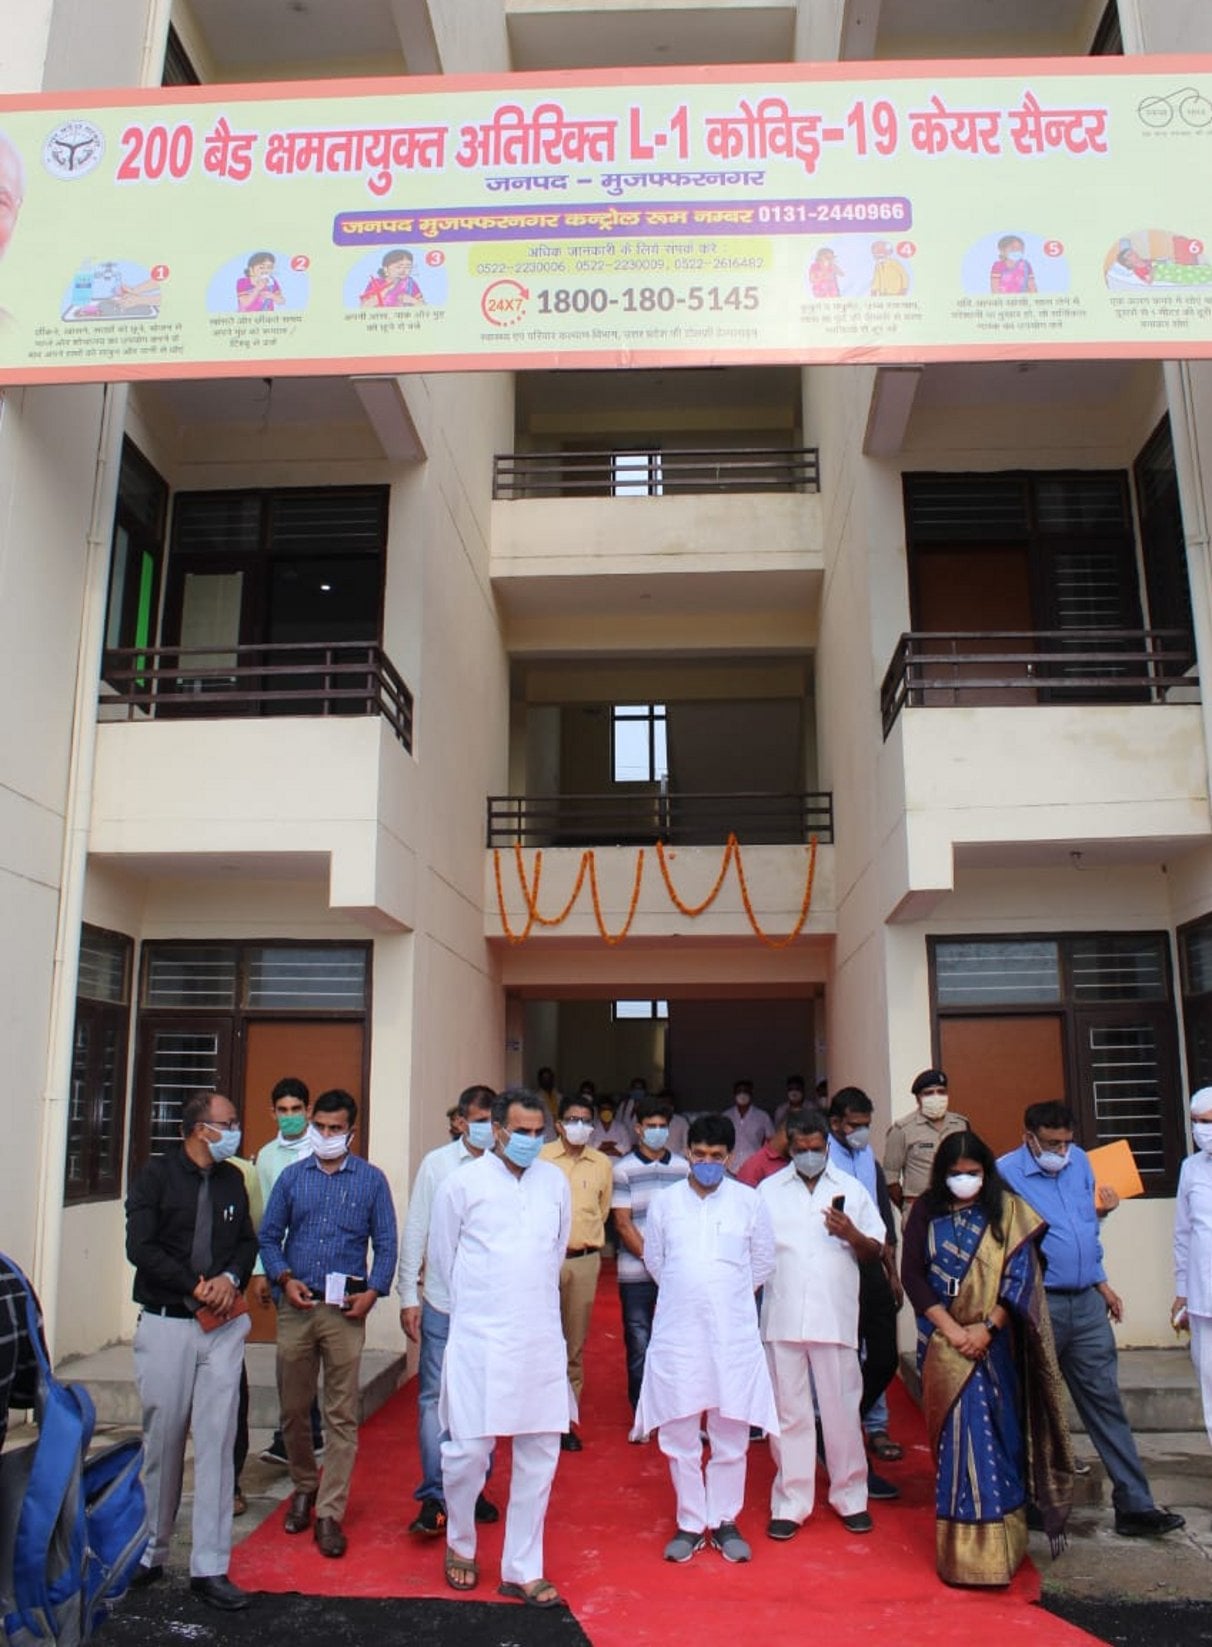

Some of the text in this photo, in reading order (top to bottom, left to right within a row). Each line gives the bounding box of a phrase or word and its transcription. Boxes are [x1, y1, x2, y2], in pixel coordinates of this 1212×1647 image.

[116, 124, 194, 181] 200
[203, 116, 259, 182] बैड
[264, 126, 449, 196] क्षमतायुक्त
[455, 103, 619, 168] अतिरिक्त
[629, 104, 689, 160] L-1
[908, 95, 1002, 155] केयर
[1007, 90, 1109, 155] सैन्टर
[484, 174, 570, 192] जनपद
[600, 170, 766, 196] मुजफ्फरनगर
[340, 203, 906, 239] जनपद मुजफ्फरनगर कन्ट्रोल रूम नम्बर 0131-2440966
[567, 242, 616, 257] जानकारी
[536, 285, 760, 314] 1800-180-5145
